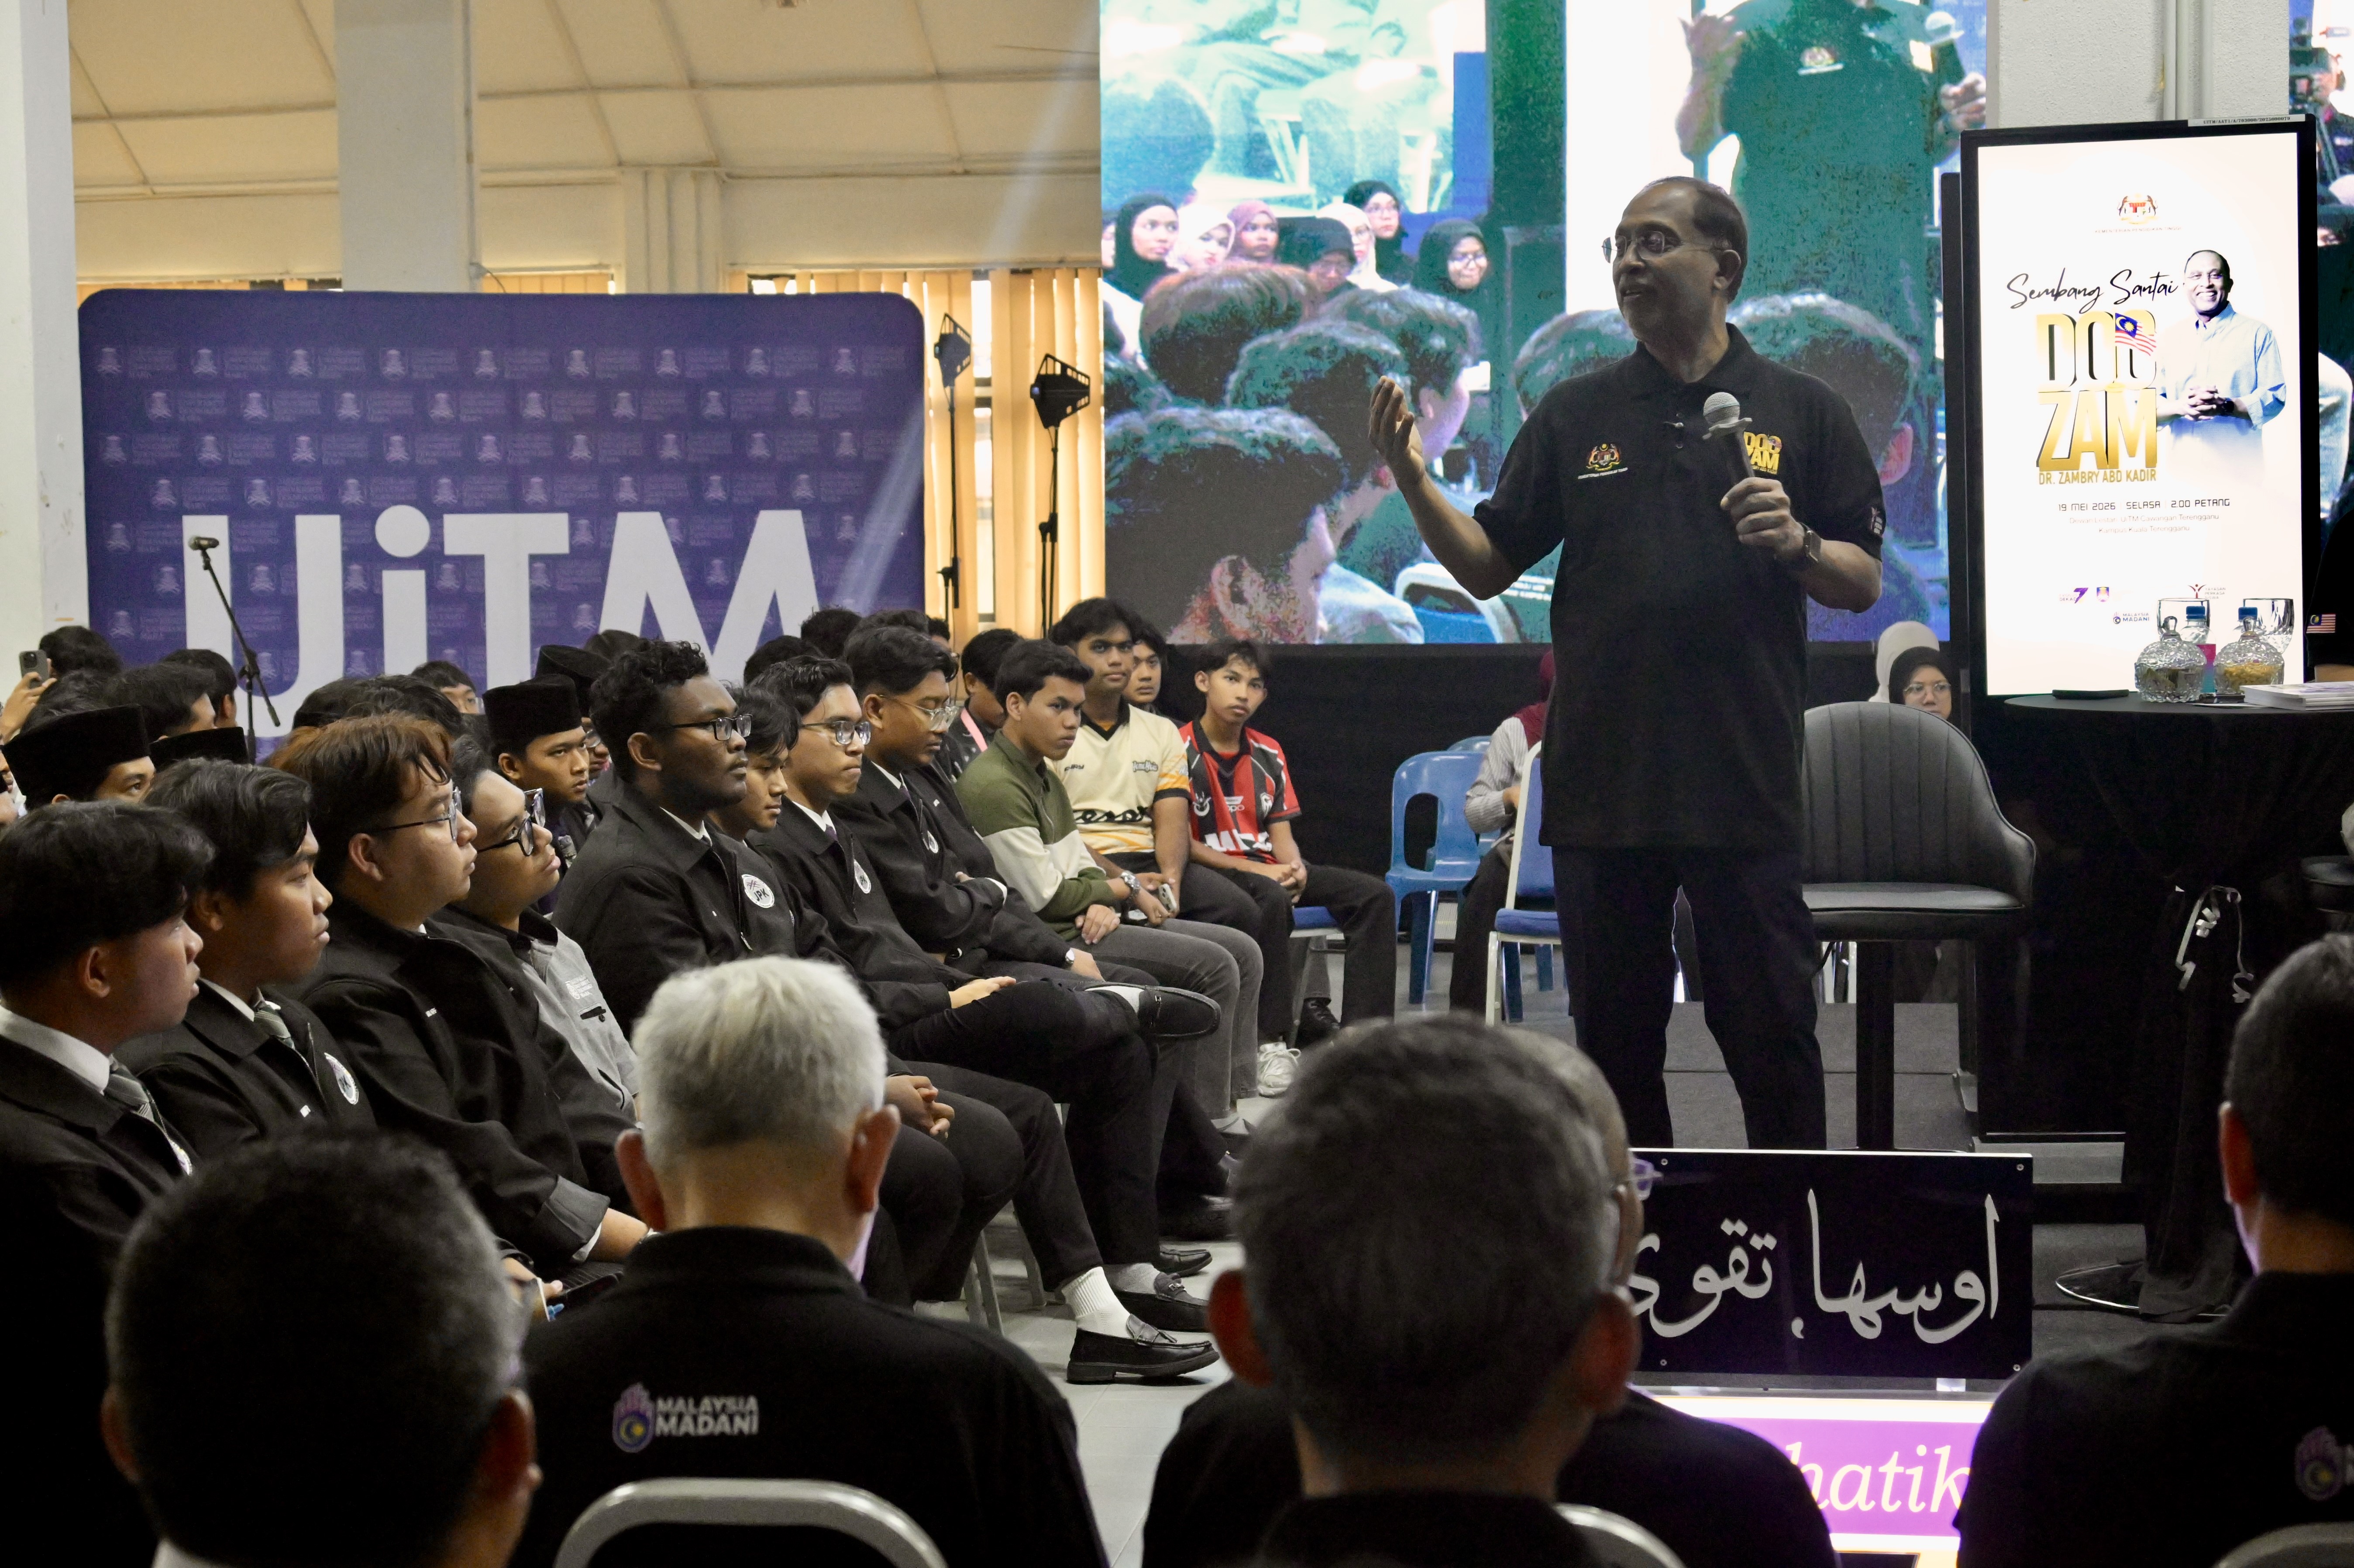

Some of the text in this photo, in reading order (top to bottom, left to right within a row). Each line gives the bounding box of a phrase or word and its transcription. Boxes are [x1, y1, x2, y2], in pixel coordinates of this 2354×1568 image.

[2006, 267, 2178, 314] Sembang Santai
[2036, 388, 2157, 471] ZAM
[2039, 468, 2157, 485] DR. ZAMBRY ABD KADIR
[2195, 499, 2230, 507] PETANG
[182, 505, 821, 739] UiTM
[754, 888, 769, 901] JPK
[656, 1396, 759, 1414] MALAYSIA
[656, 1414, 759, 1436] MADANI
